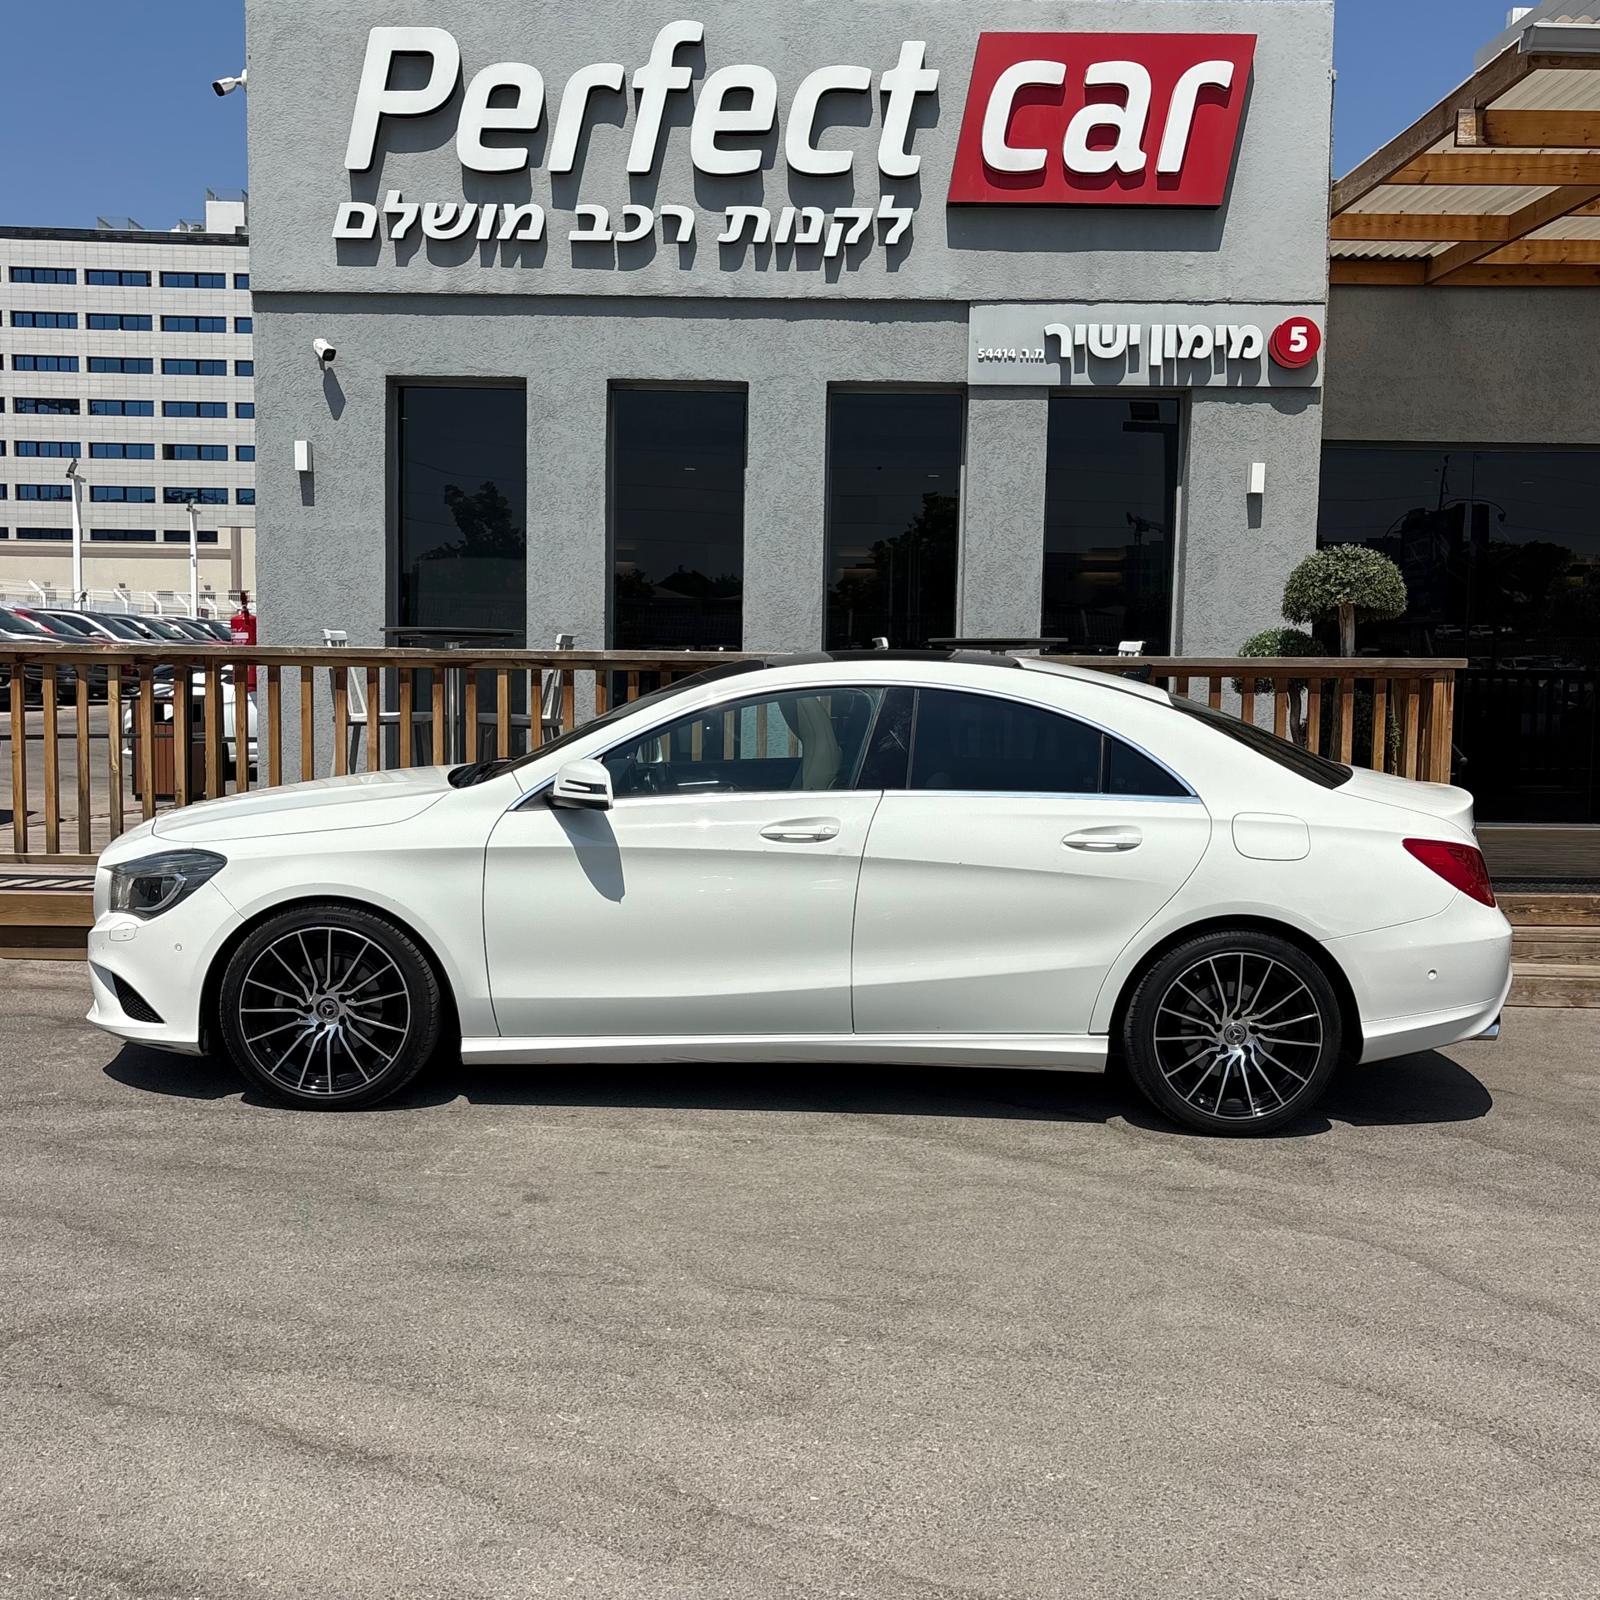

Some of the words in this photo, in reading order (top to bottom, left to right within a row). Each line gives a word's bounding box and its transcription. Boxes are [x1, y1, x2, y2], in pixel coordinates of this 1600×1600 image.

[344, 20, 940, 176] Perfect
[981, 60, 1235, 173] car
[332, 190, 547, 241] מושלם
[568, 204, 696, 242] רכב
[717, 195, 914, 257] לקנות
[977, 348, 1017, 359] 54414
[1043, 322, 1142, 360] ישיר
[1149, 324, 1265, 366] מימון
[1288, 326, 1308, 353] 5
